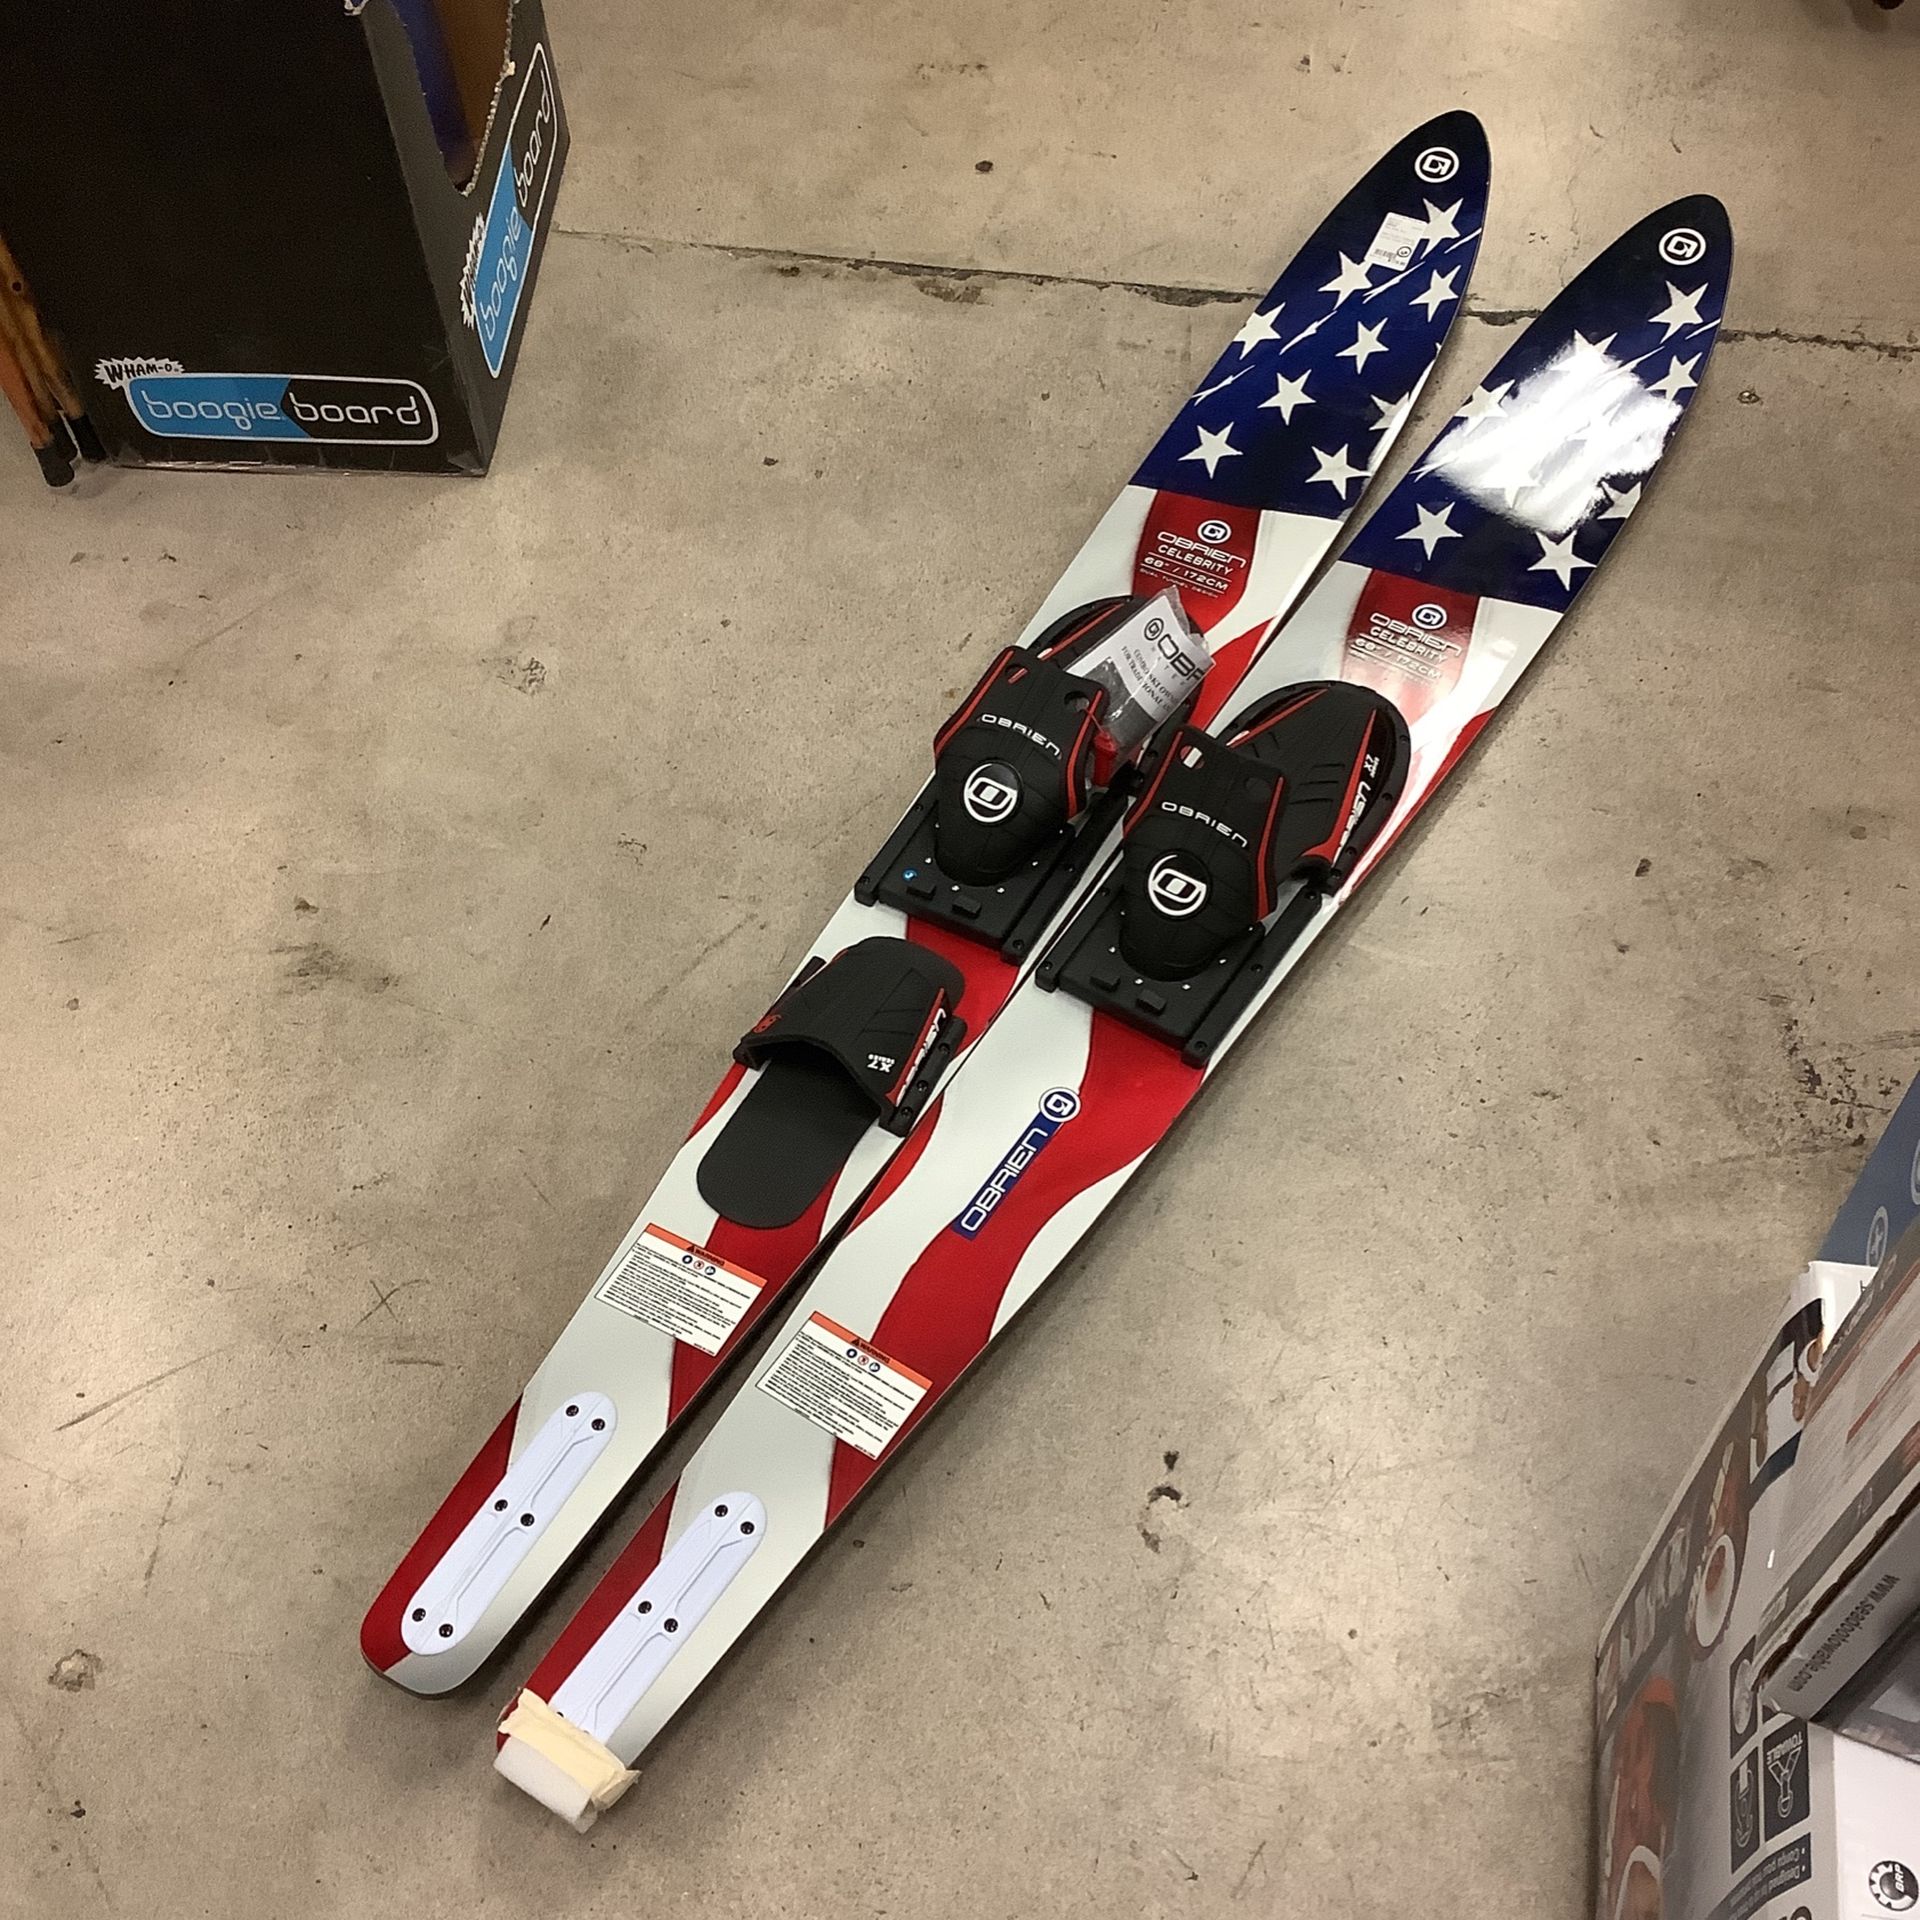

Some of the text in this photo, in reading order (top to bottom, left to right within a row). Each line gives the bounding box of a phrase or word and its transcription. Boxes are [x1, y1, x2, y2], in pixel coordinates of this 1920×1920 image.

[480, 69, 550, 341] boogie board
[104, 362, 173, 383] WHAM-O
[141, 390, 420, 430] boogie board
[1157, 531, 1246, 568] OBRIEN
[1157, 544, 1233, 575] CELEBRITY
[1183, 570, 1229, 591] 172CM
[1369, 612, 1462, 656] OBRIEN
[1370, 626, 1447, 663] CELEBRITY
[981, 713, 1060, 757] OBRIEN
[1161, 801, 1247, 848] OBRIEN
[961, 1127, 1048, 1231] OBRIEN
[1894, 1863, 1905, 1892] BRP
